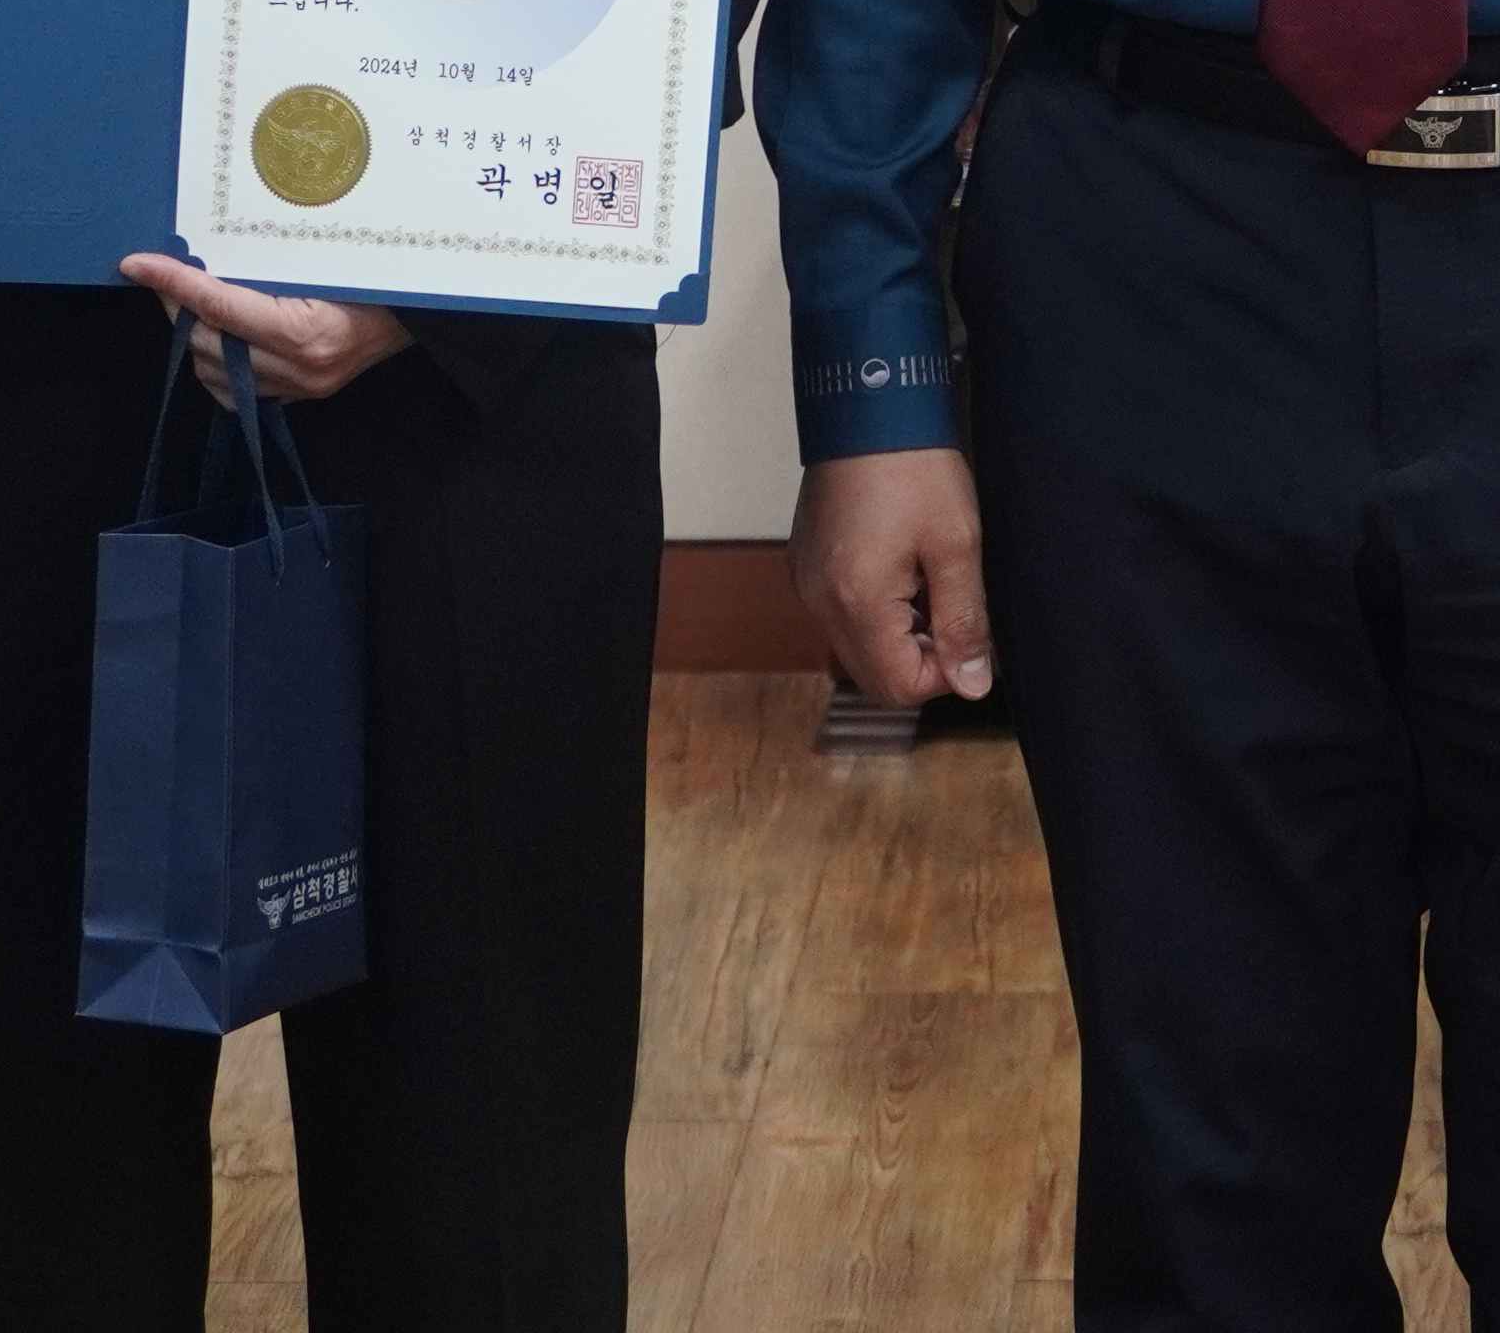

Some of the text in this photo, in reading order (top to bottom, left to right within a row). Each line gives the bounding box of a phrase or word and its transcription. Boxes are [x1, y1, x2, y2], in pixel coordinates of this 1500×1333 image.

[358, 56, 534, 87] 2024년 10월 14일
[477, 164, 617, 210] 곽병일
